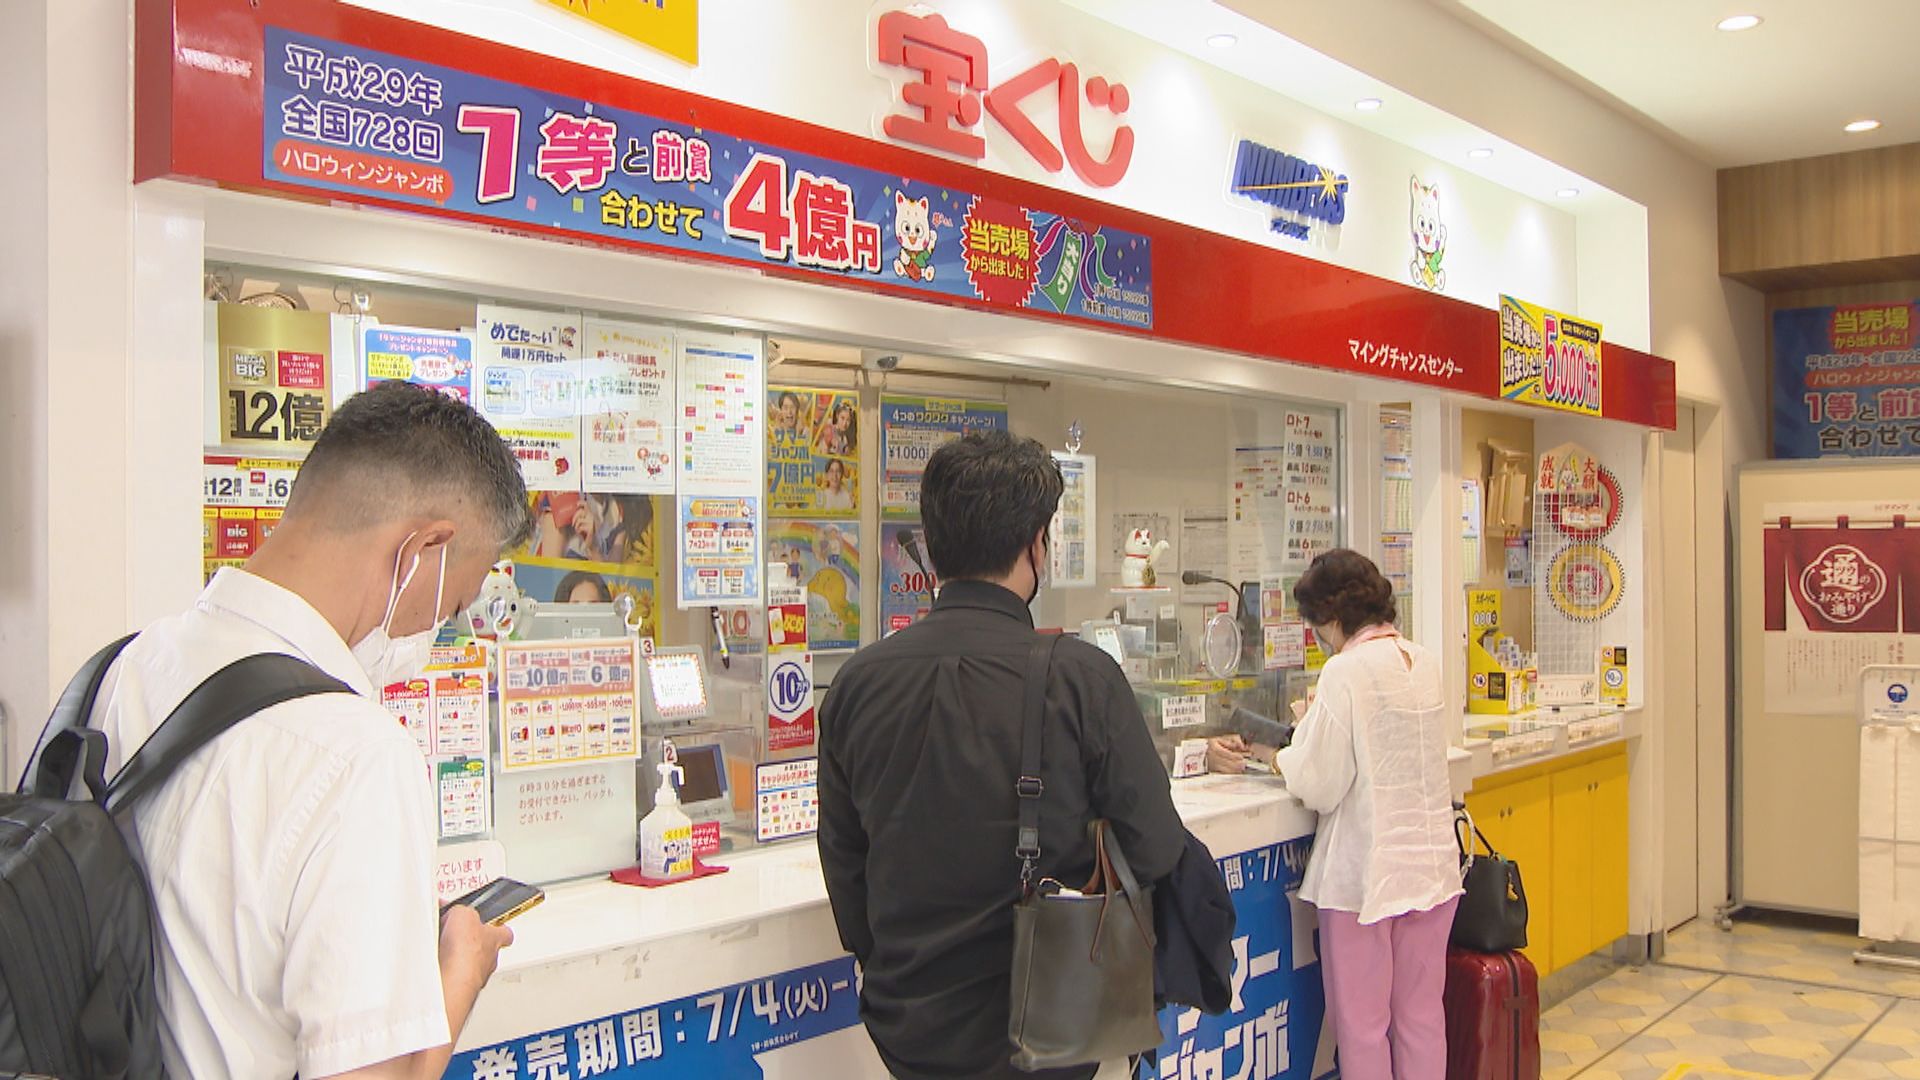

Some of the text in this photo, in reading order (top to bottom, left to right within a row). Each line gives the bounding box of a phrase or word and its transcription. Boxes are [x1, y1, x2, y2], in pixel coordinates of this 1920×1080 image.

[284, 43, 444, 113] 平成29年
[878, 10, 1134, 189] 宝くじ
[281, 96, 444, 163] 全国728回
[281, 153, 446, 195] ハロウィンジャンボ
[600, 192, 704, 241] 合わせて
[724, 152, 883, 276] 4億円
[969, 218, 1030, 261] 当売場
[1834, 307, 1909, 334] 当売場
[235, 363, 267, 378] BIG
[1348, 339, 1464, 376] マイングチャンスセンター
[643, 639, 653, 654] 3
[665, 744, 675, 762] 2
